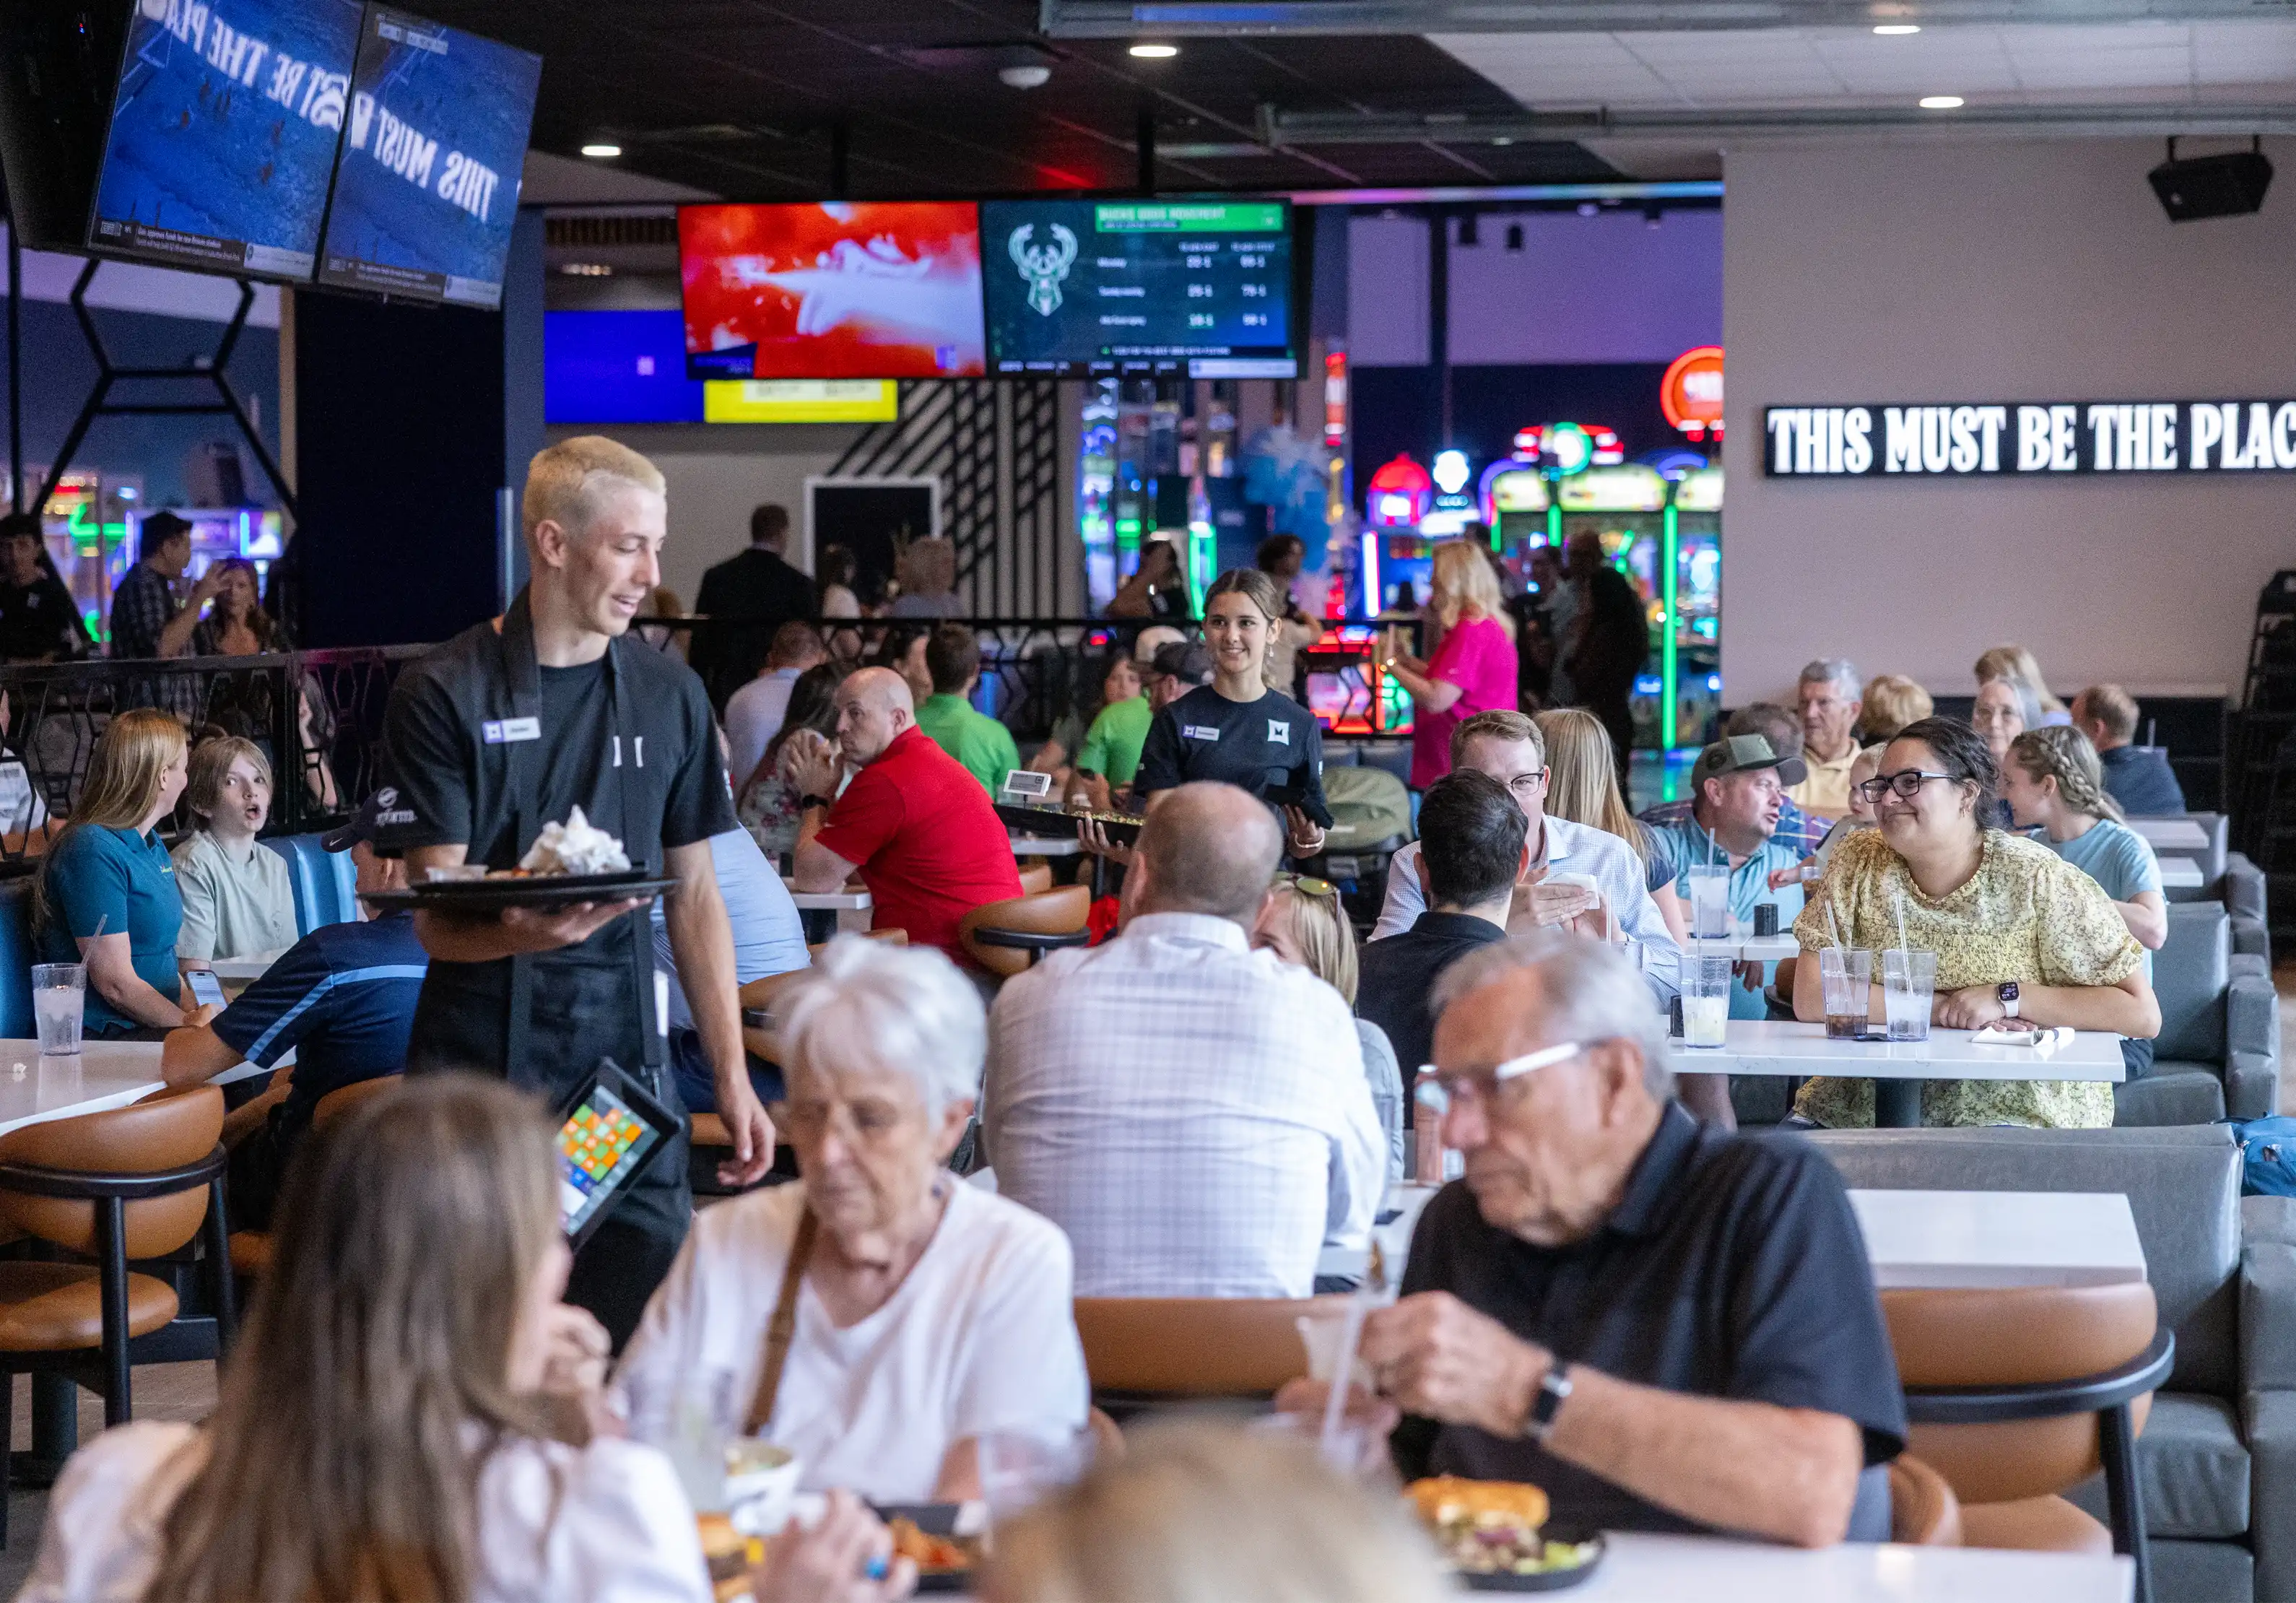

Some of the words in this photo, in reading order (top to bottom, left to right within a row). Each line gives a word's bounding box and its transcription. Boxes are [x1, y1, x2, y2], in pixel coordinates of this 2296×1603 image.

[1767, 407, 1873, 473] THIS
[1883, 406, 2006, 472] MUST
[2017, 405, 2077, 470] BE
[2087, 404, 2178, 469] THE
[2189, 401, 2296, 469] PLAC
